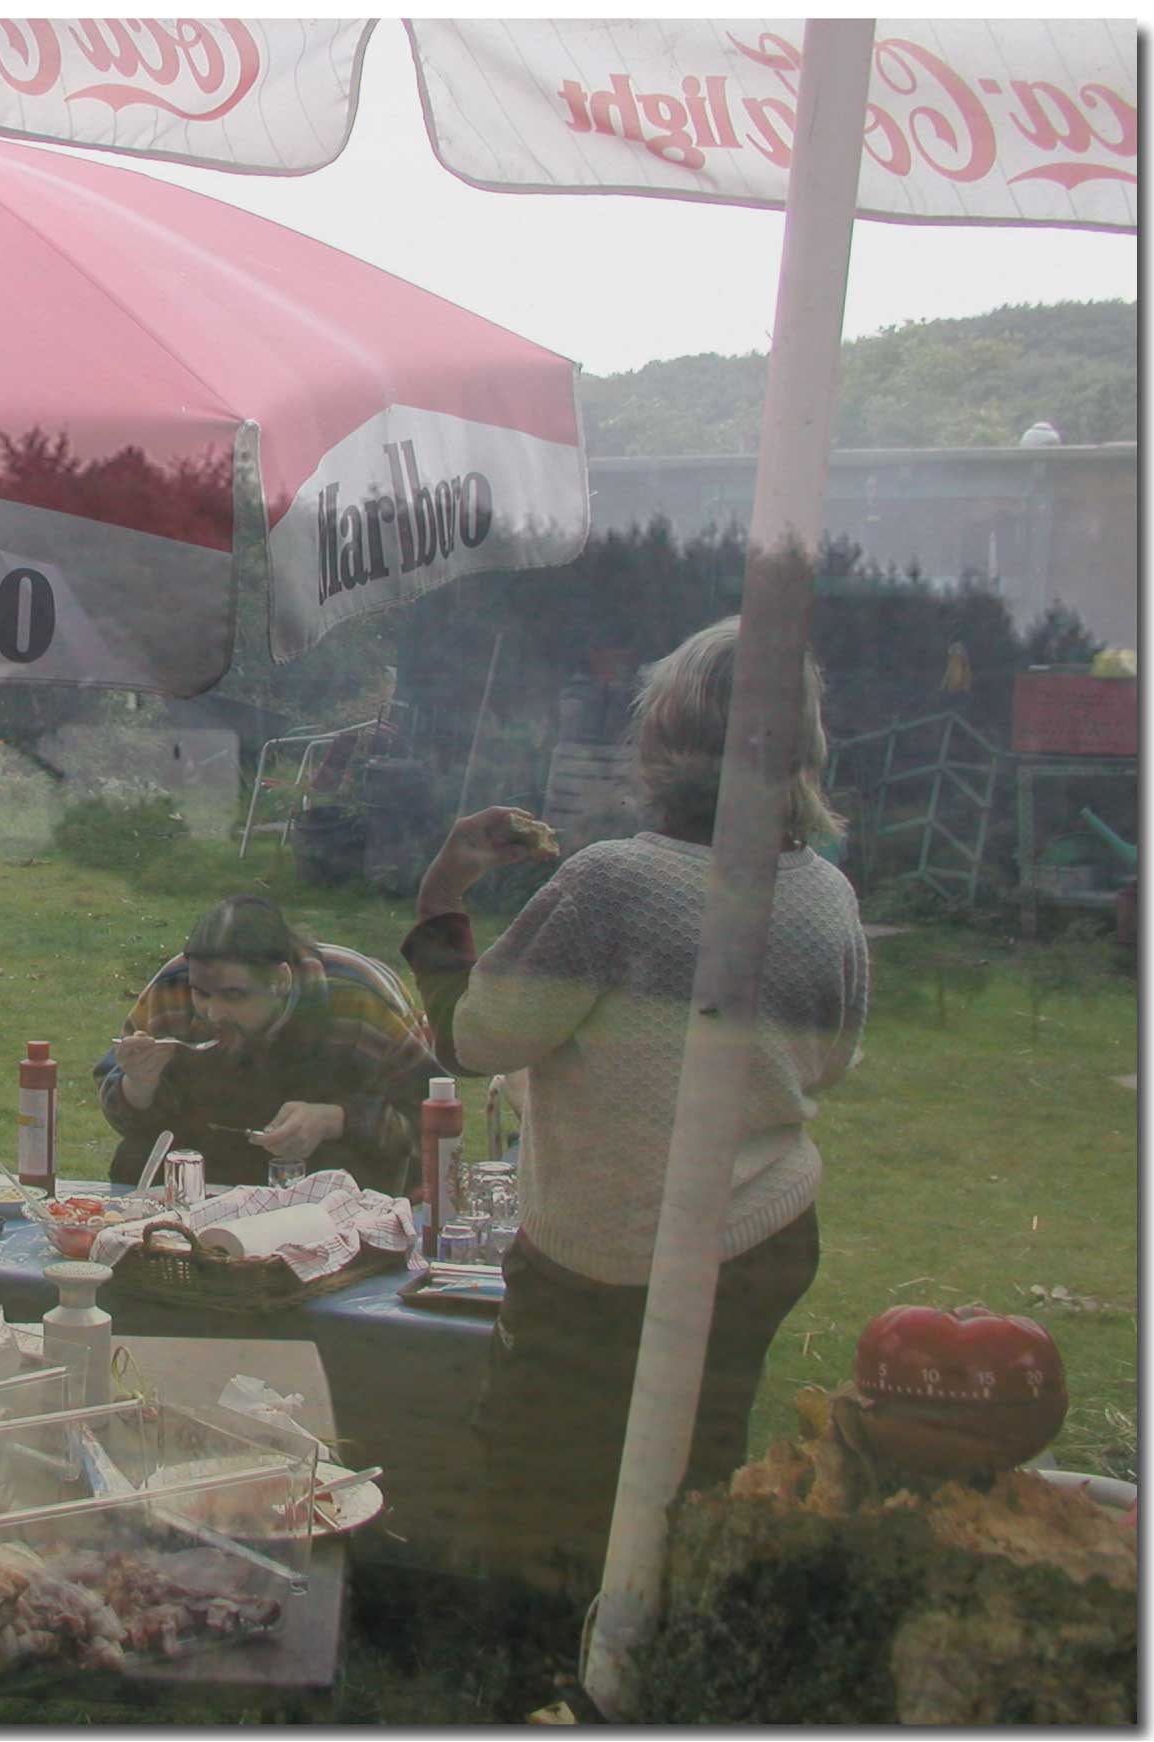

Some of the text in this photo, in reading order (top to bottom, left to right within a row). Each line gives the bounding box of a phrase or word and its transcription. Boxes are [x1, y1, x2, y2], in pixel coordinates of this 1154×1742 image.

[878, 1363, 1044, 1386] 5 10 15 20
